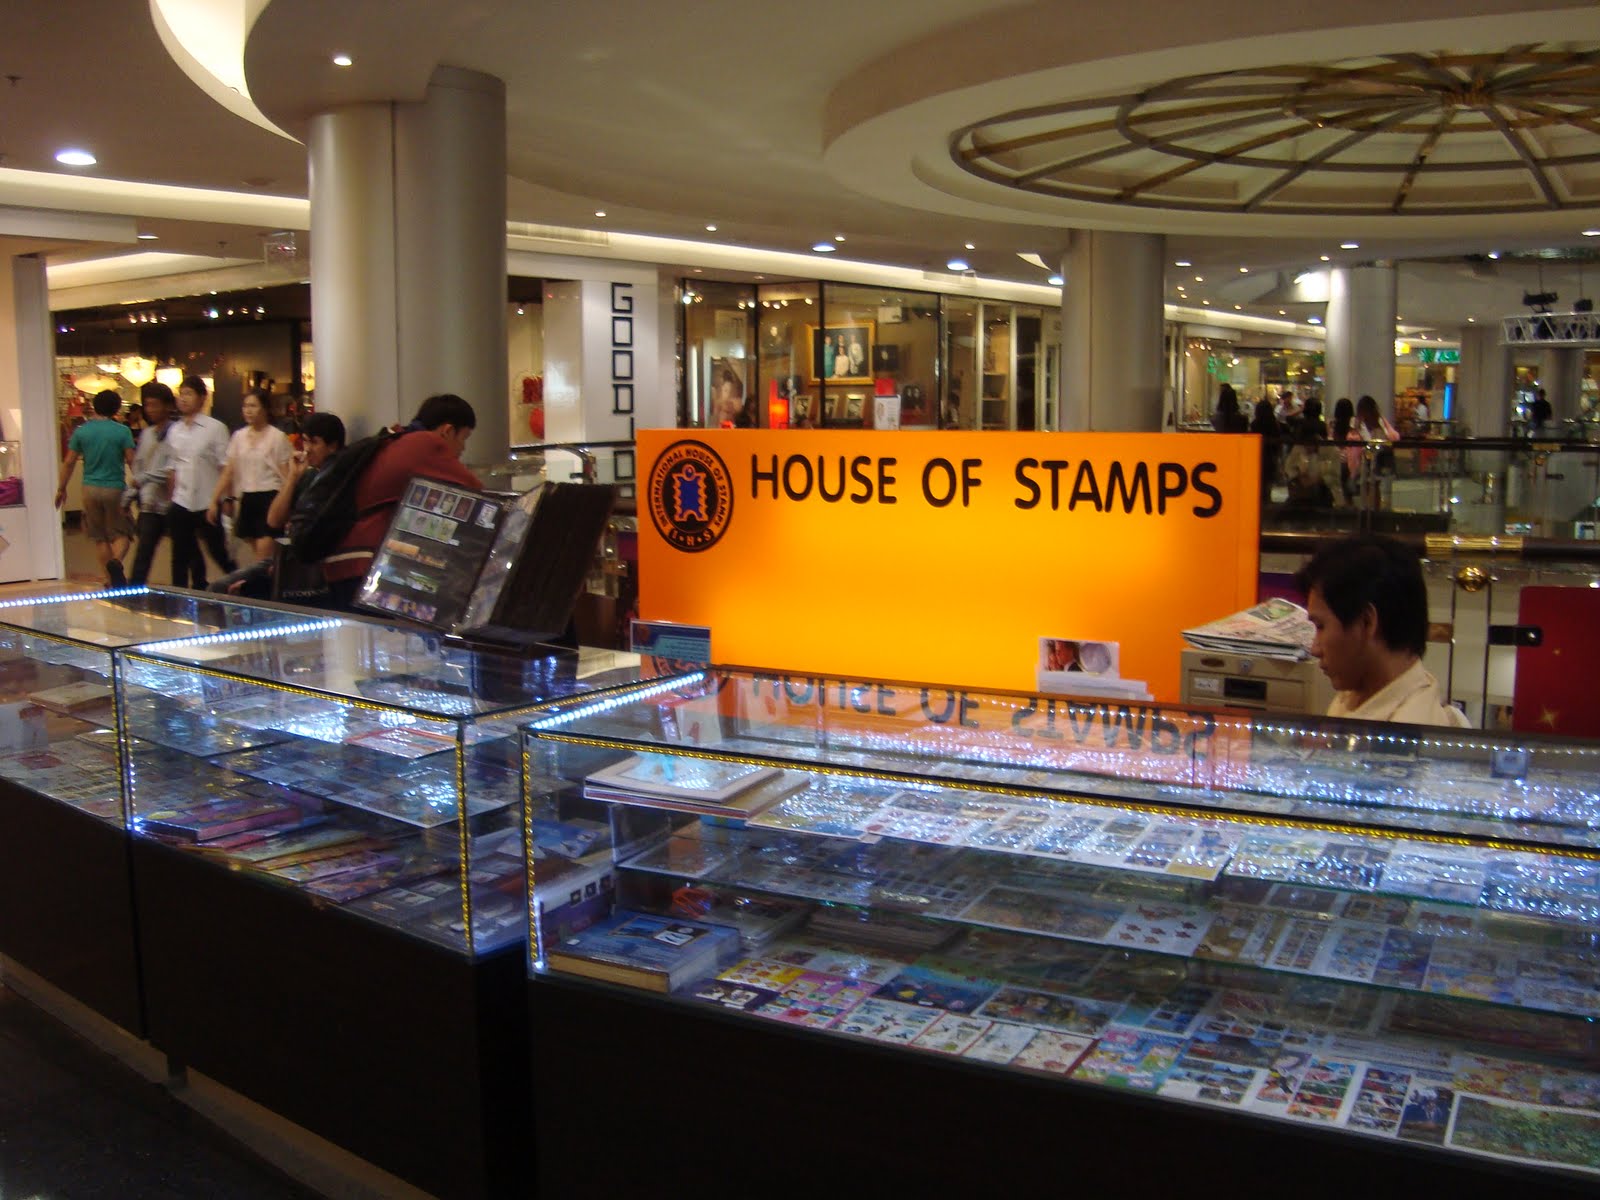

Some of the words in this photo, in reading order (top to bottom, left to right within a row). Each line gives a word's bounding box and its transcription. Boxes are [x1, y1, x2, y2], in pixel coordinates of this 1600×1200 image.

[685, 448, 714, 468] HOUSE
[713, 468, 724, 481] OF
[653, 449, 683, 528] INTERNATIONAL
[714, 485, 728, 527] STAMPS
[751, 454, 897, 504] HOUSE
[922, 457, 983, 508] OF
[1014, 457, 1223, 518] STAMPS
